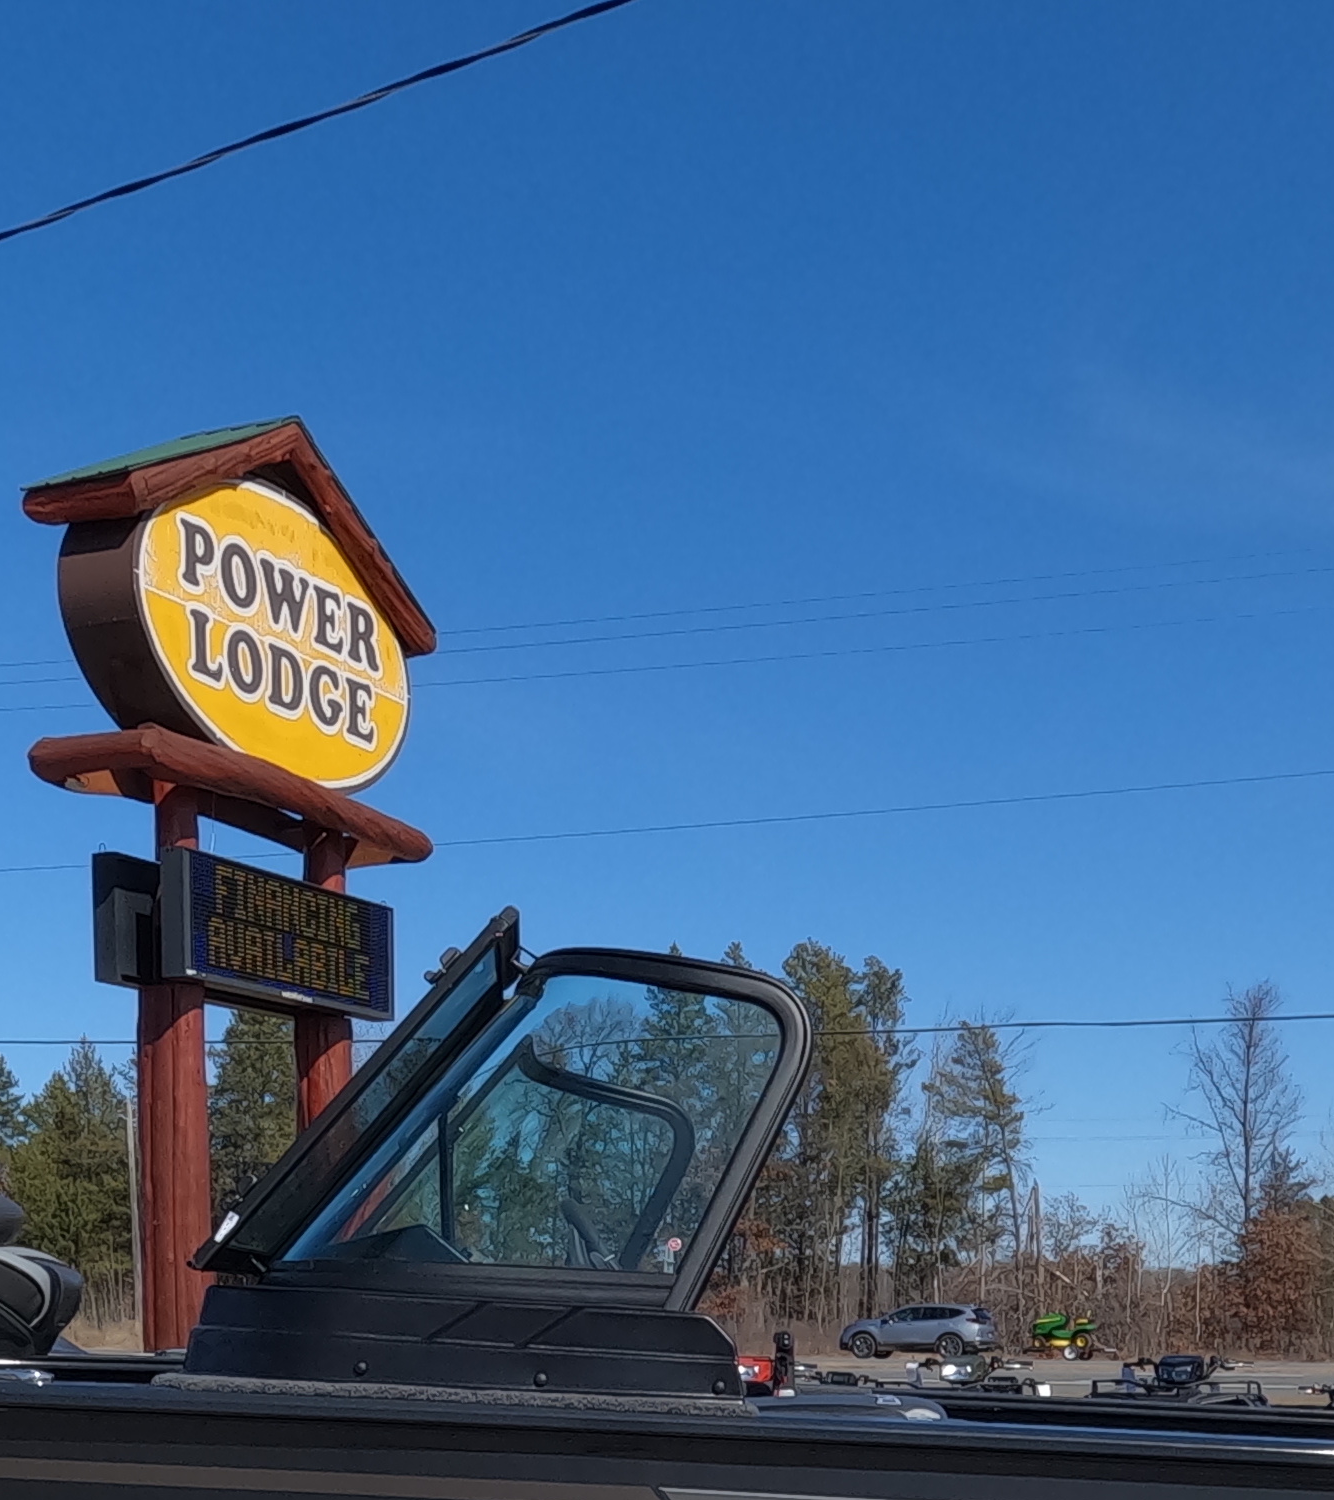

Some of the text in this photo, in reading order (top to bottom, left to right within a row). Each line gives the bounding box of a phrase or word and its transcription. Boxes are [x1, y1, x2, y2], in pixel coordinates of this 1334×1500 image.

[178, 515, 380, 674] POWER
[187, 607, 376, 746] LODGE
[214, 864, 361, 950] FINANCING
